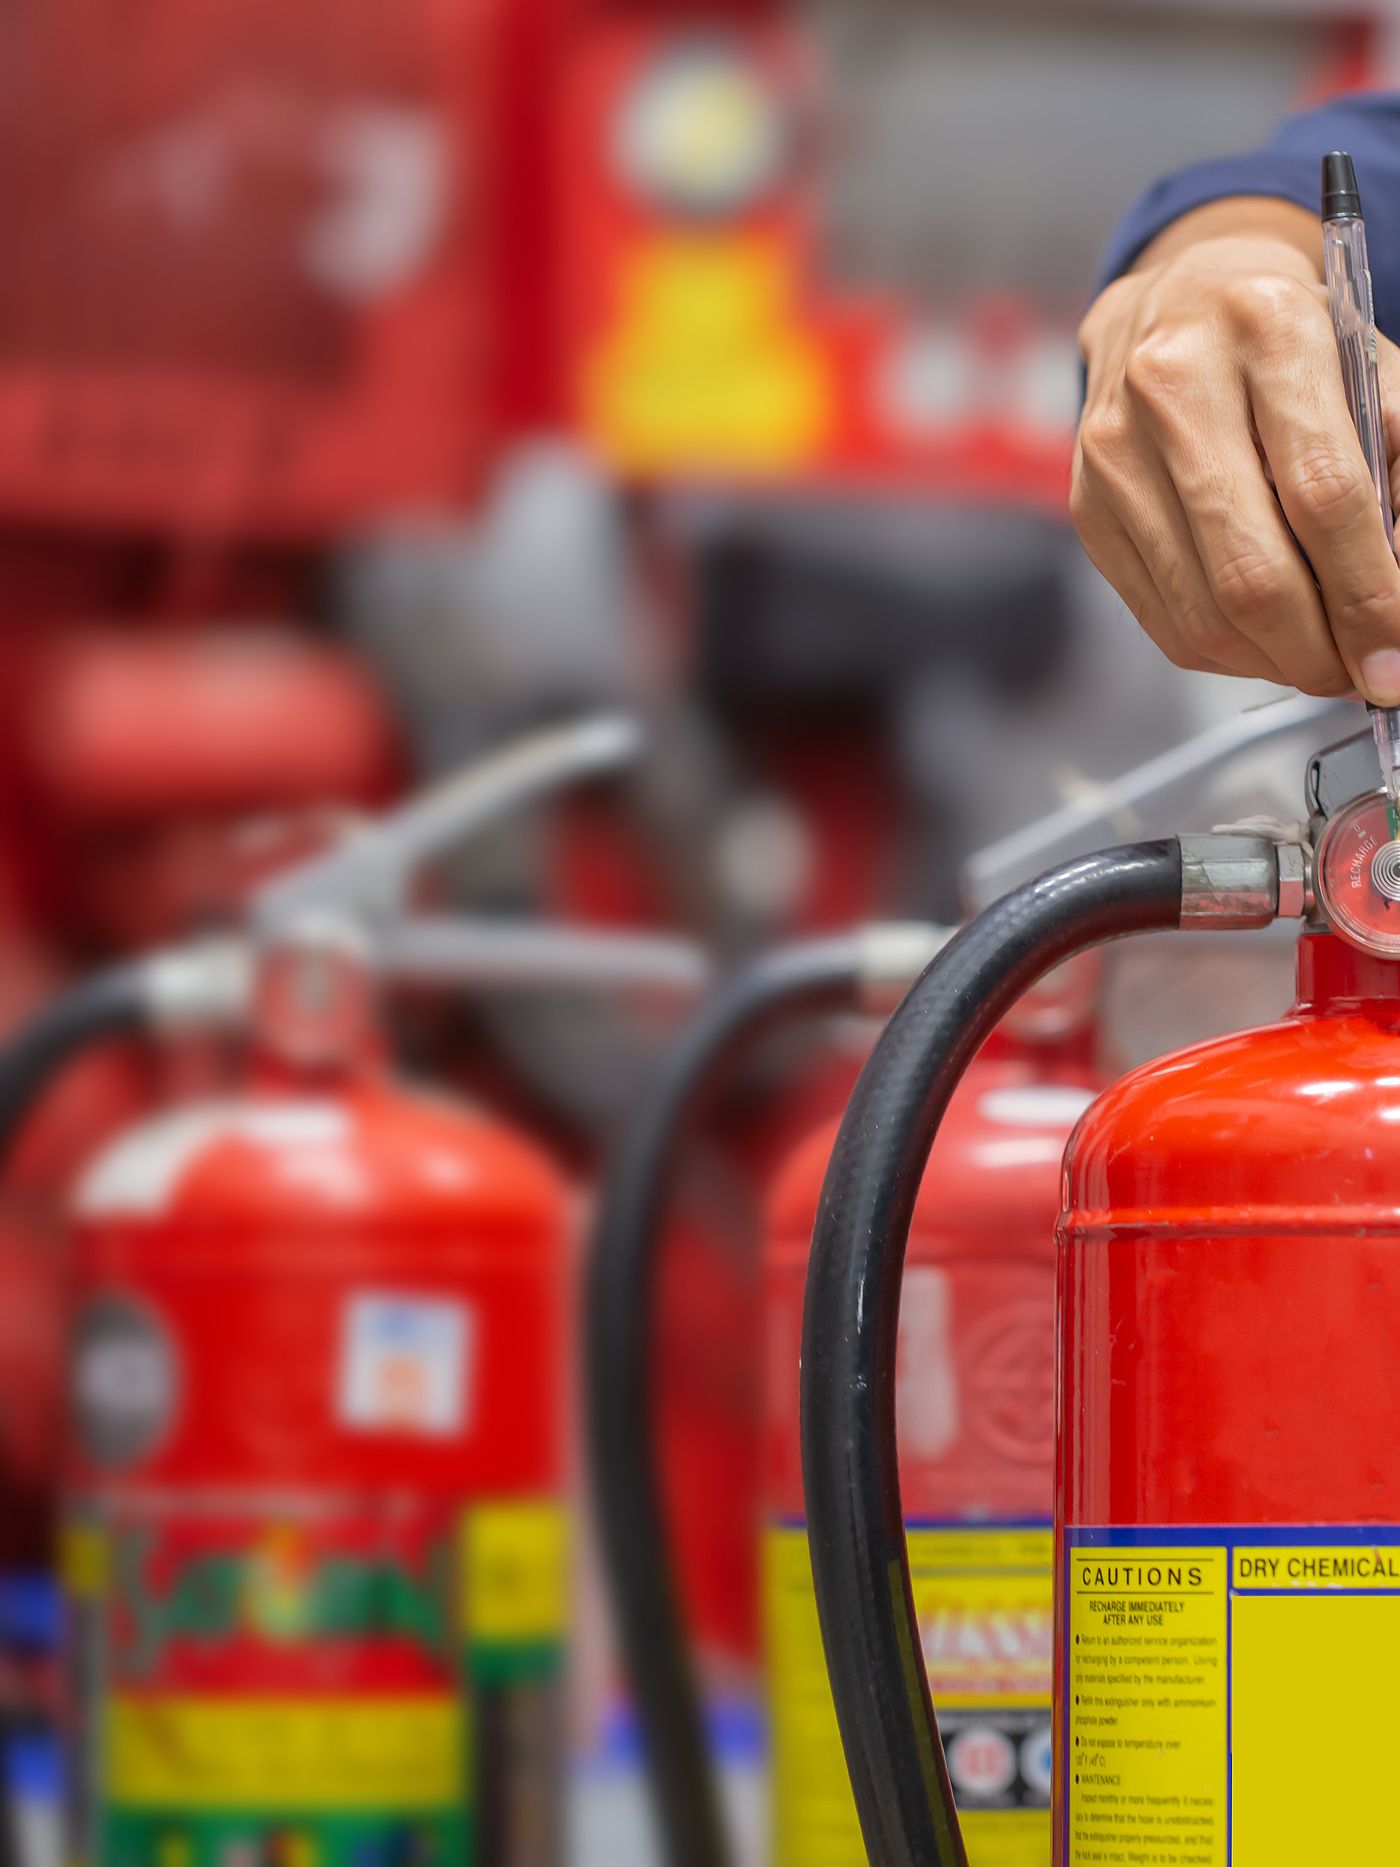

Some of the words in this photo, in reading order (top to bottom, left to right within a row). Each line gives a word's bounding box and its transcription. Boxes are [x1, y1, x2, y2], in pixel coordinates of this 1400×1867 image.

[1240, 1558, 1279, 1577] DRY
[1287, 1558, 1399, 1577] CHEMICAL
[1082, 1567, 1202, 1586] CAUTIONS
[1089, 1600, 1126, 1612] RECHARGE
[1129, 1601, 1184, 1612] IMMEDIATELY
[1103, 1614, 1126, 1625] AFTER
[1128, 1614, 1144, 1625] ANY
[1147, 1615, 1163, 1625] USE
[1082, 1774, 1121, 1785] MAINTENANCE
